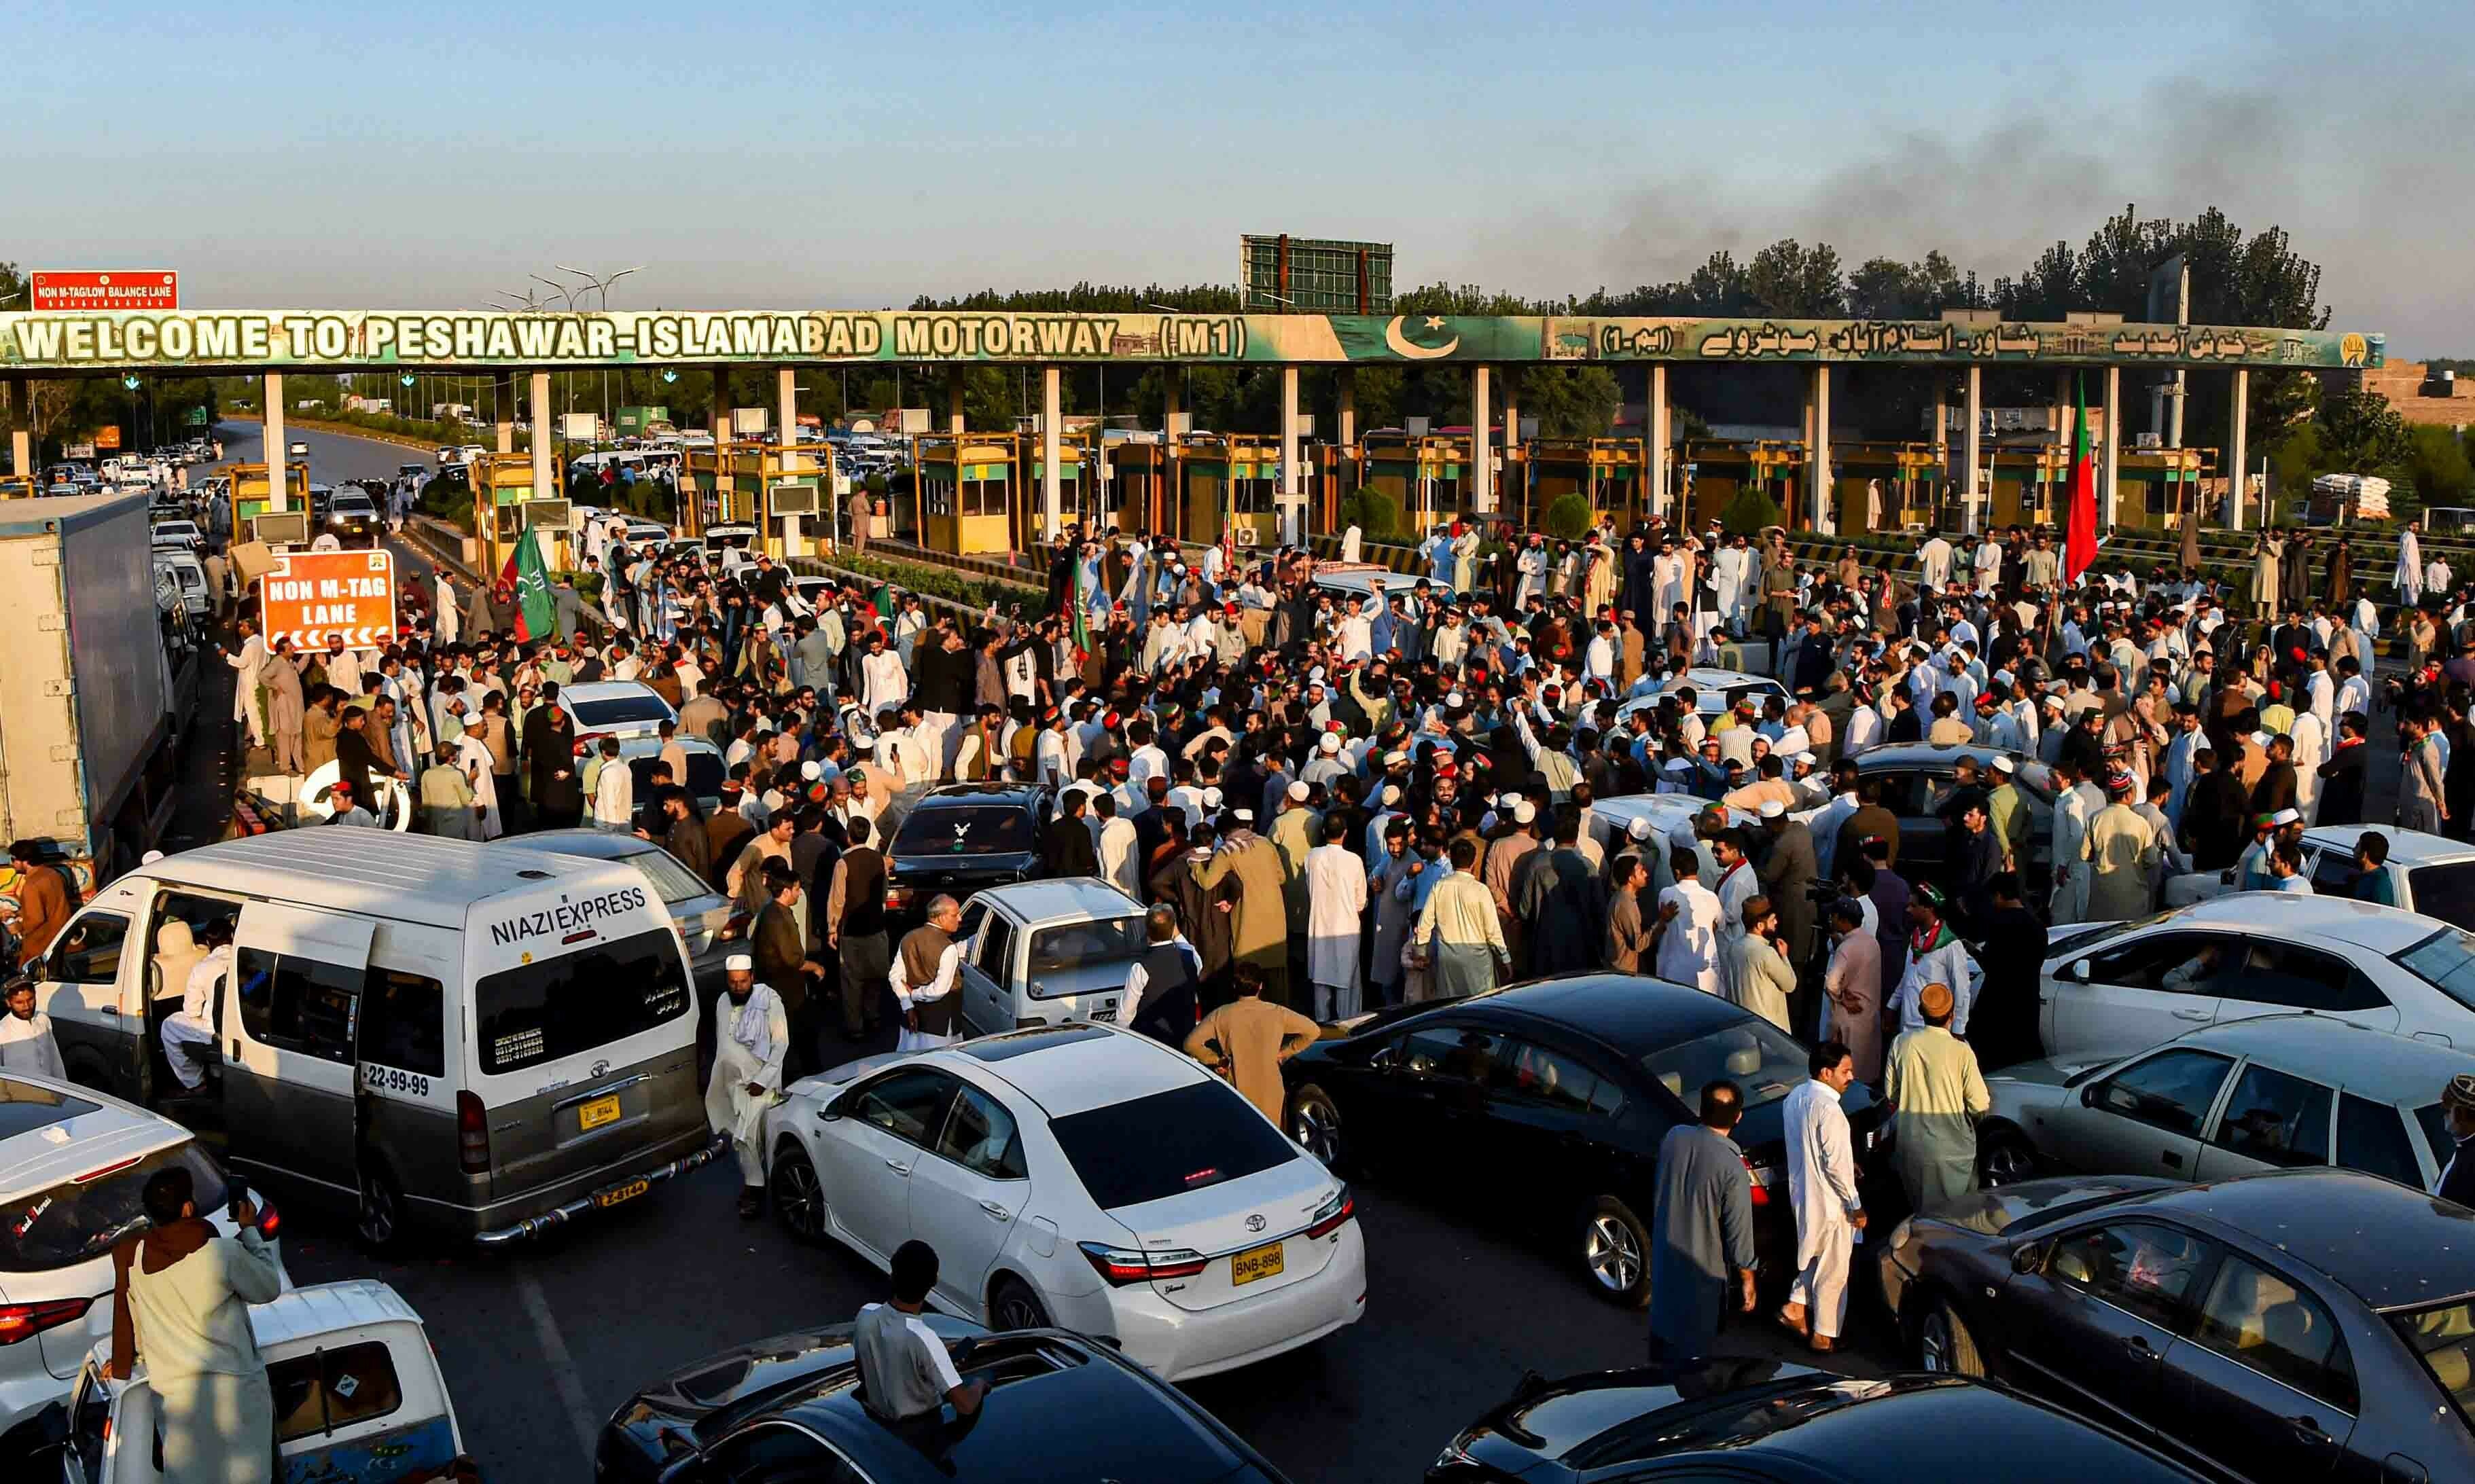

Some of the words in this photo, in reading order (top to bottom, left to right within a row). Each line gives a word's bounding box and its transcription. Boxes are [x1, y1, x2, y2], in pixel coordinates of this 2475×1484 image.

[38, 287, 57, 298] NON
[108, 287, 147, 297] BALANCE
[149, 287, 171, 297] LANE
[14, 316, 269, 361] WELCOME
[283, 316, 351, 360] TO
[895, 316, 1117, 359] MOTORWAY
[1159, 317, 1247, 358] (M1)
[269, 580, 313, 602] NON
[320, 577, 387, 598] M-TAG
[302, 604, 357, 625] LANE
[491, 910, 554, 946] NIAZI
[556, 887, 646, 929] EXPRESS
[1236, 1251, 1281, 1276] BNB-898
